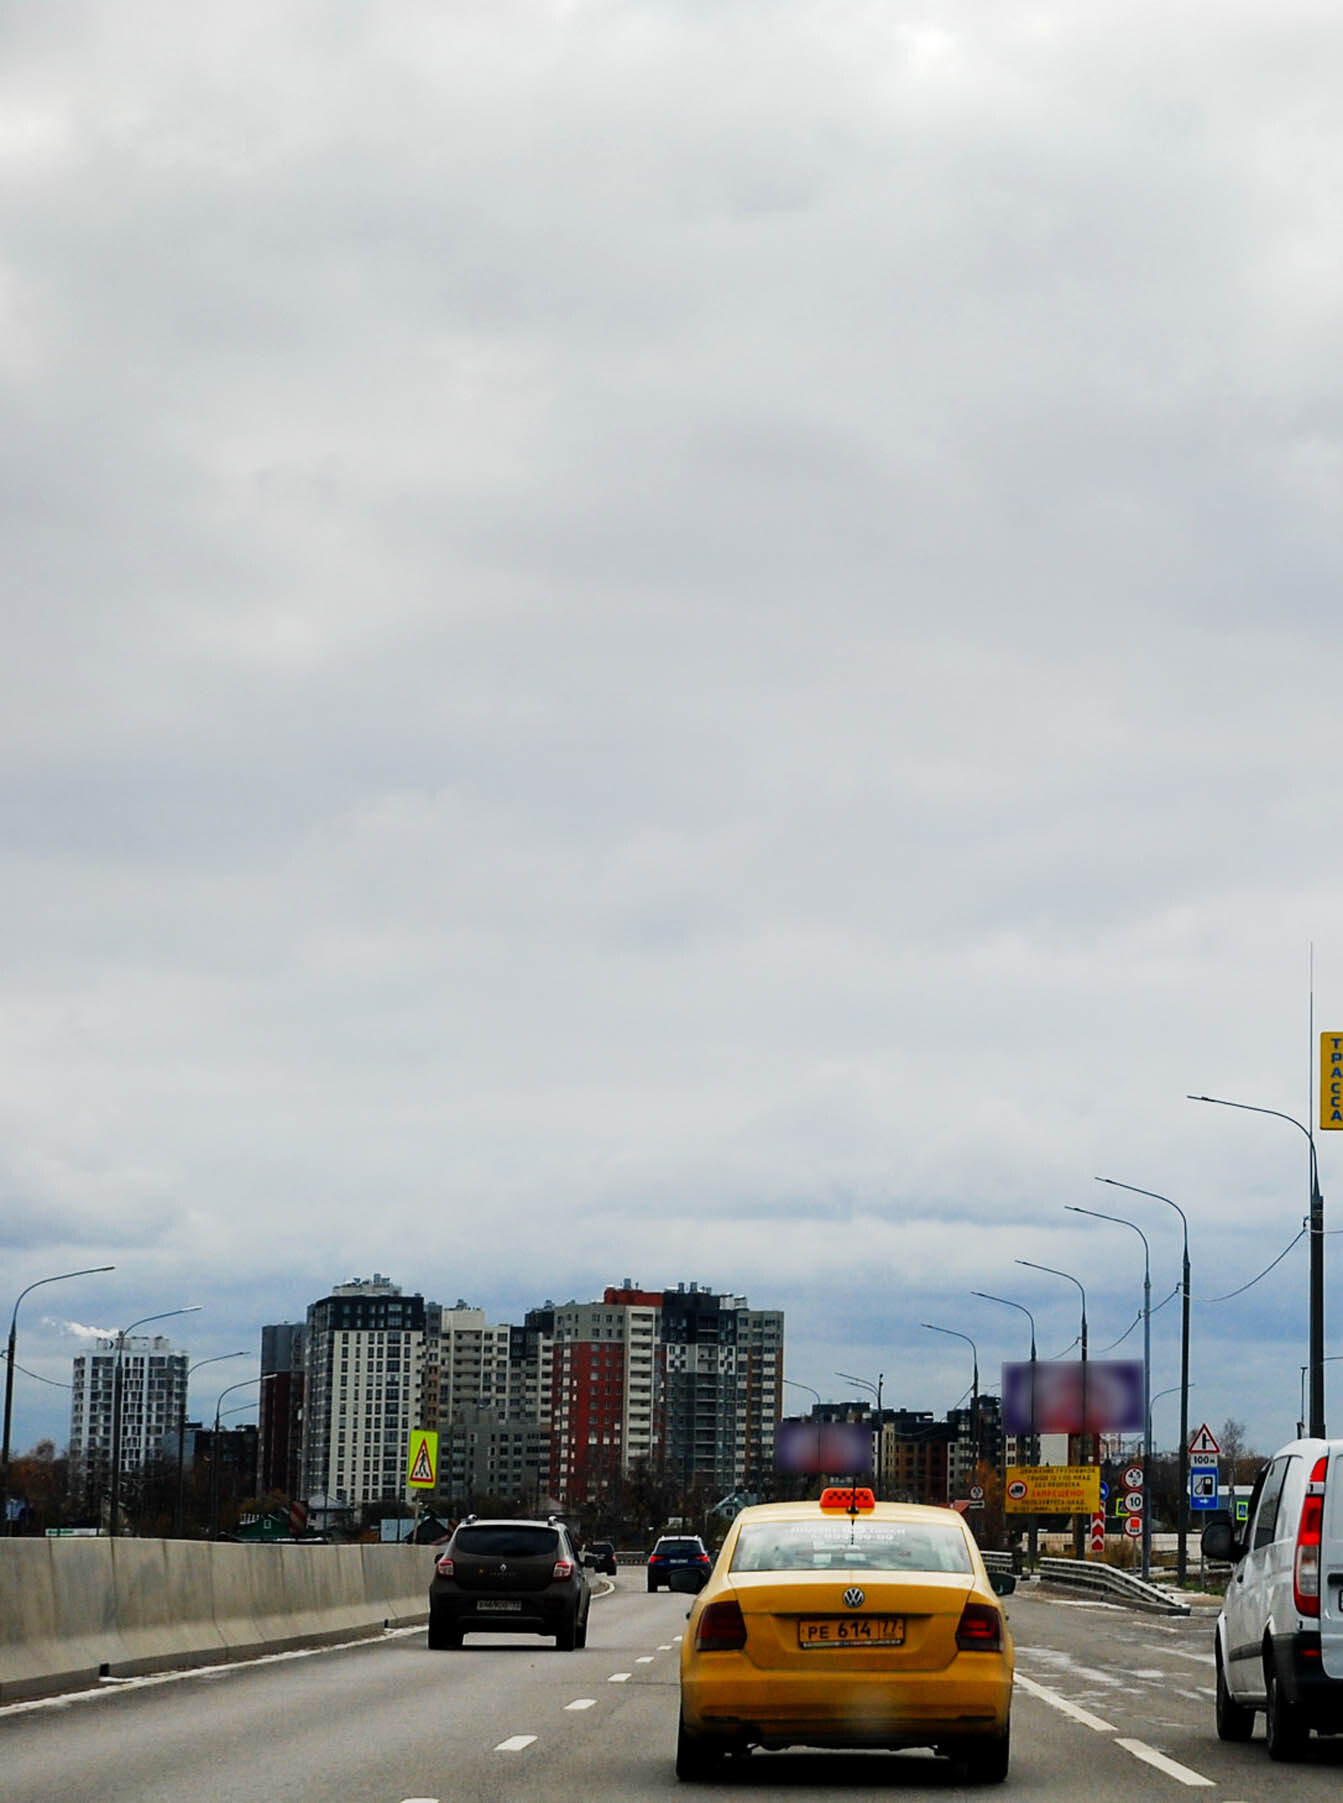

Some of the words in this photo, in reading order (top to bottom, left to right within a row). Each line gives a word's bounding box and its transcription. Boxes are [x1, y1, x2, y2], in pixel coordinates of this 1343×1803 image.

[1330, 1037, 1343, 1121] ТРАССА
[1193, 1456, 1209, 1464] 100
[1130, 1497, 1141, 1506] 10
